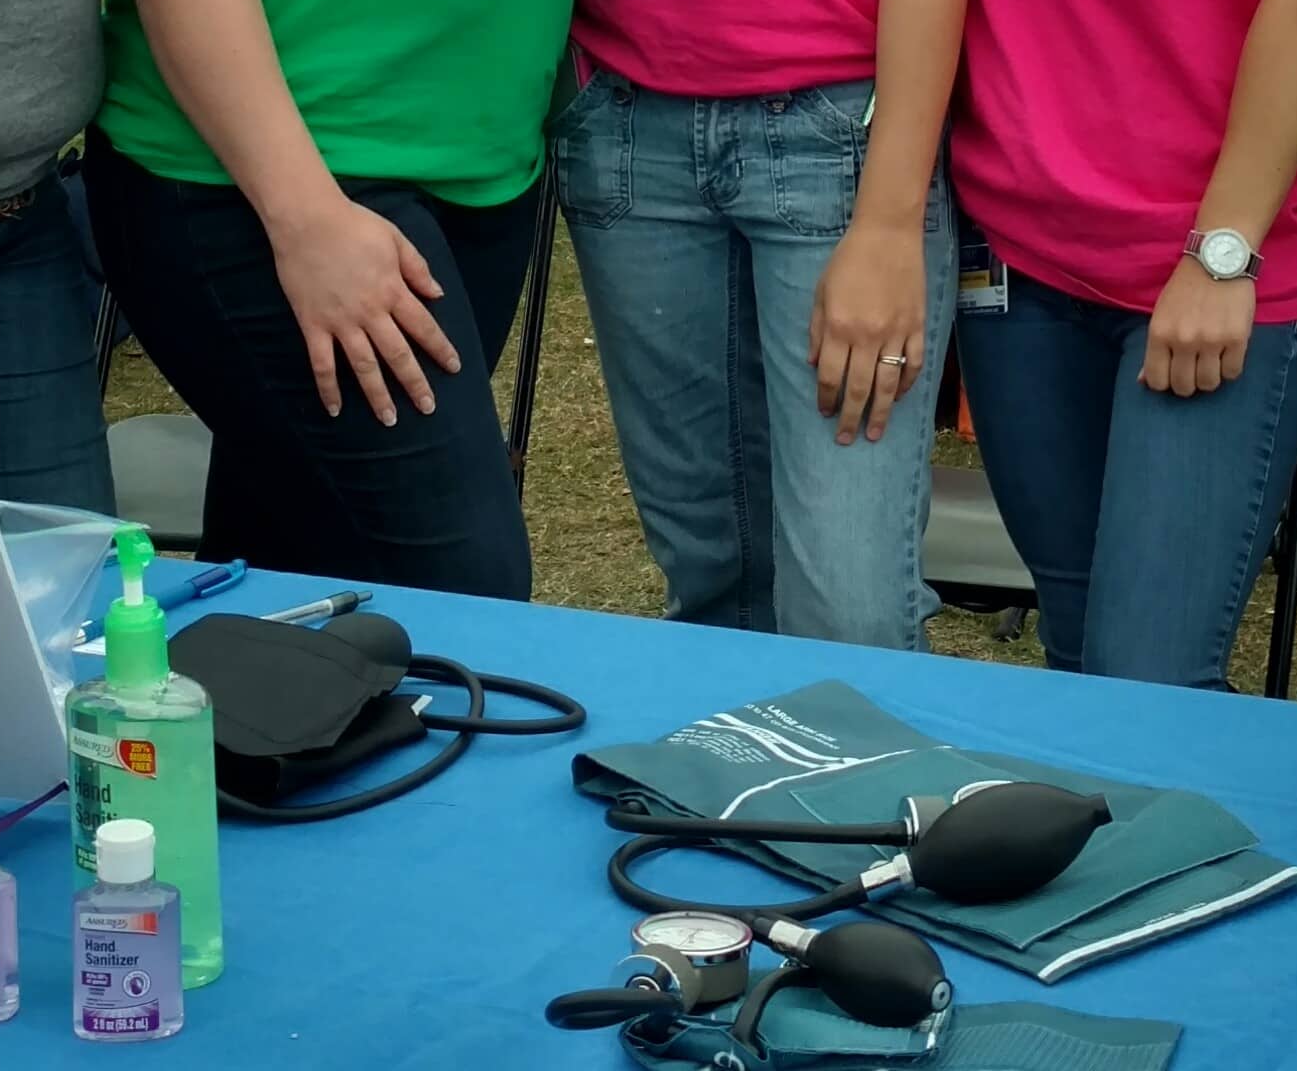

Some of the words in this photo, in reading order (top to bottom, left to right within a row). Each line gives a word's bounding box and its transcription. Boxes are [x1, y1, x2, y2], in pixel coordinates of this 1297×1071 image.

[74, 773, 112, 804] Hand
[85, 938, 116, 953] Hand
[85, 952, 140, 967] Sanitizer
